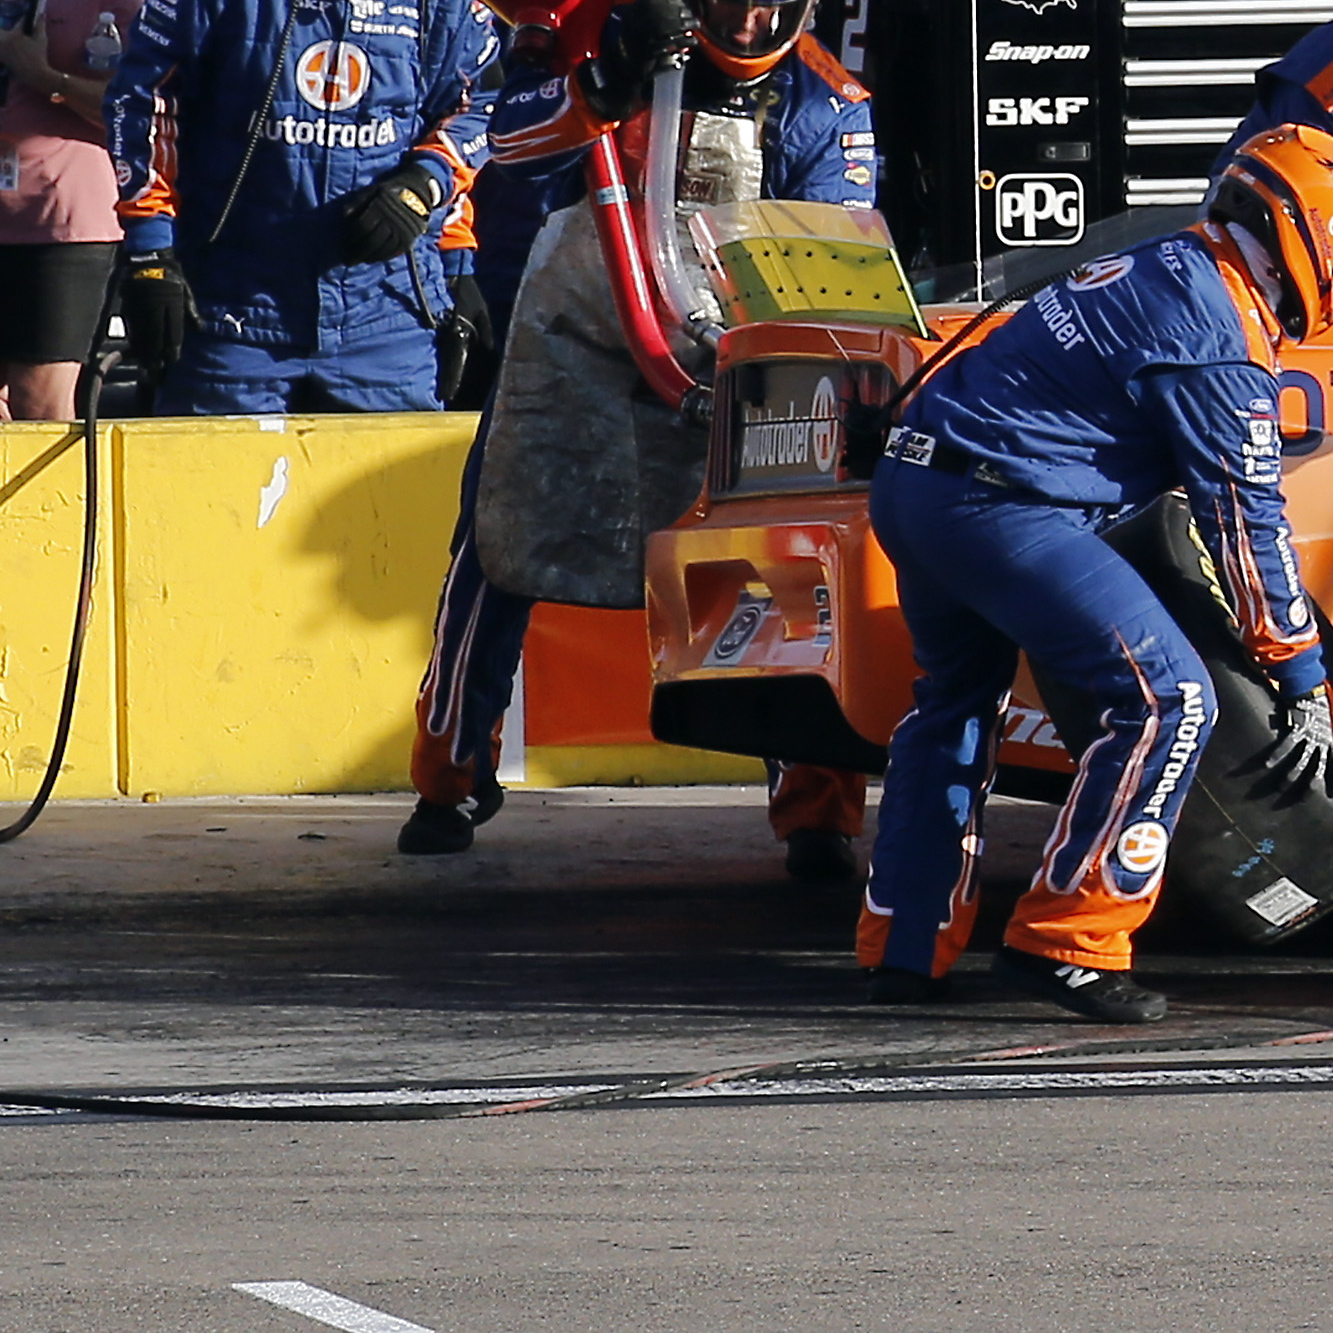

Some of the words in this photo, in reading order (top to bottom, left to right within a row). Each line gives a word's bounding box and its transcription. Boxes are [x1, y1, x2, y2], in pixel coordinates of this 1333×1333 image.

[985, 41, 1090, 64] Snap-on
[986, 97, 1089, 126] SKF
[1001, 182, 1077, 237] PPG
[1143, 681, 1206, 819] Autotrader
